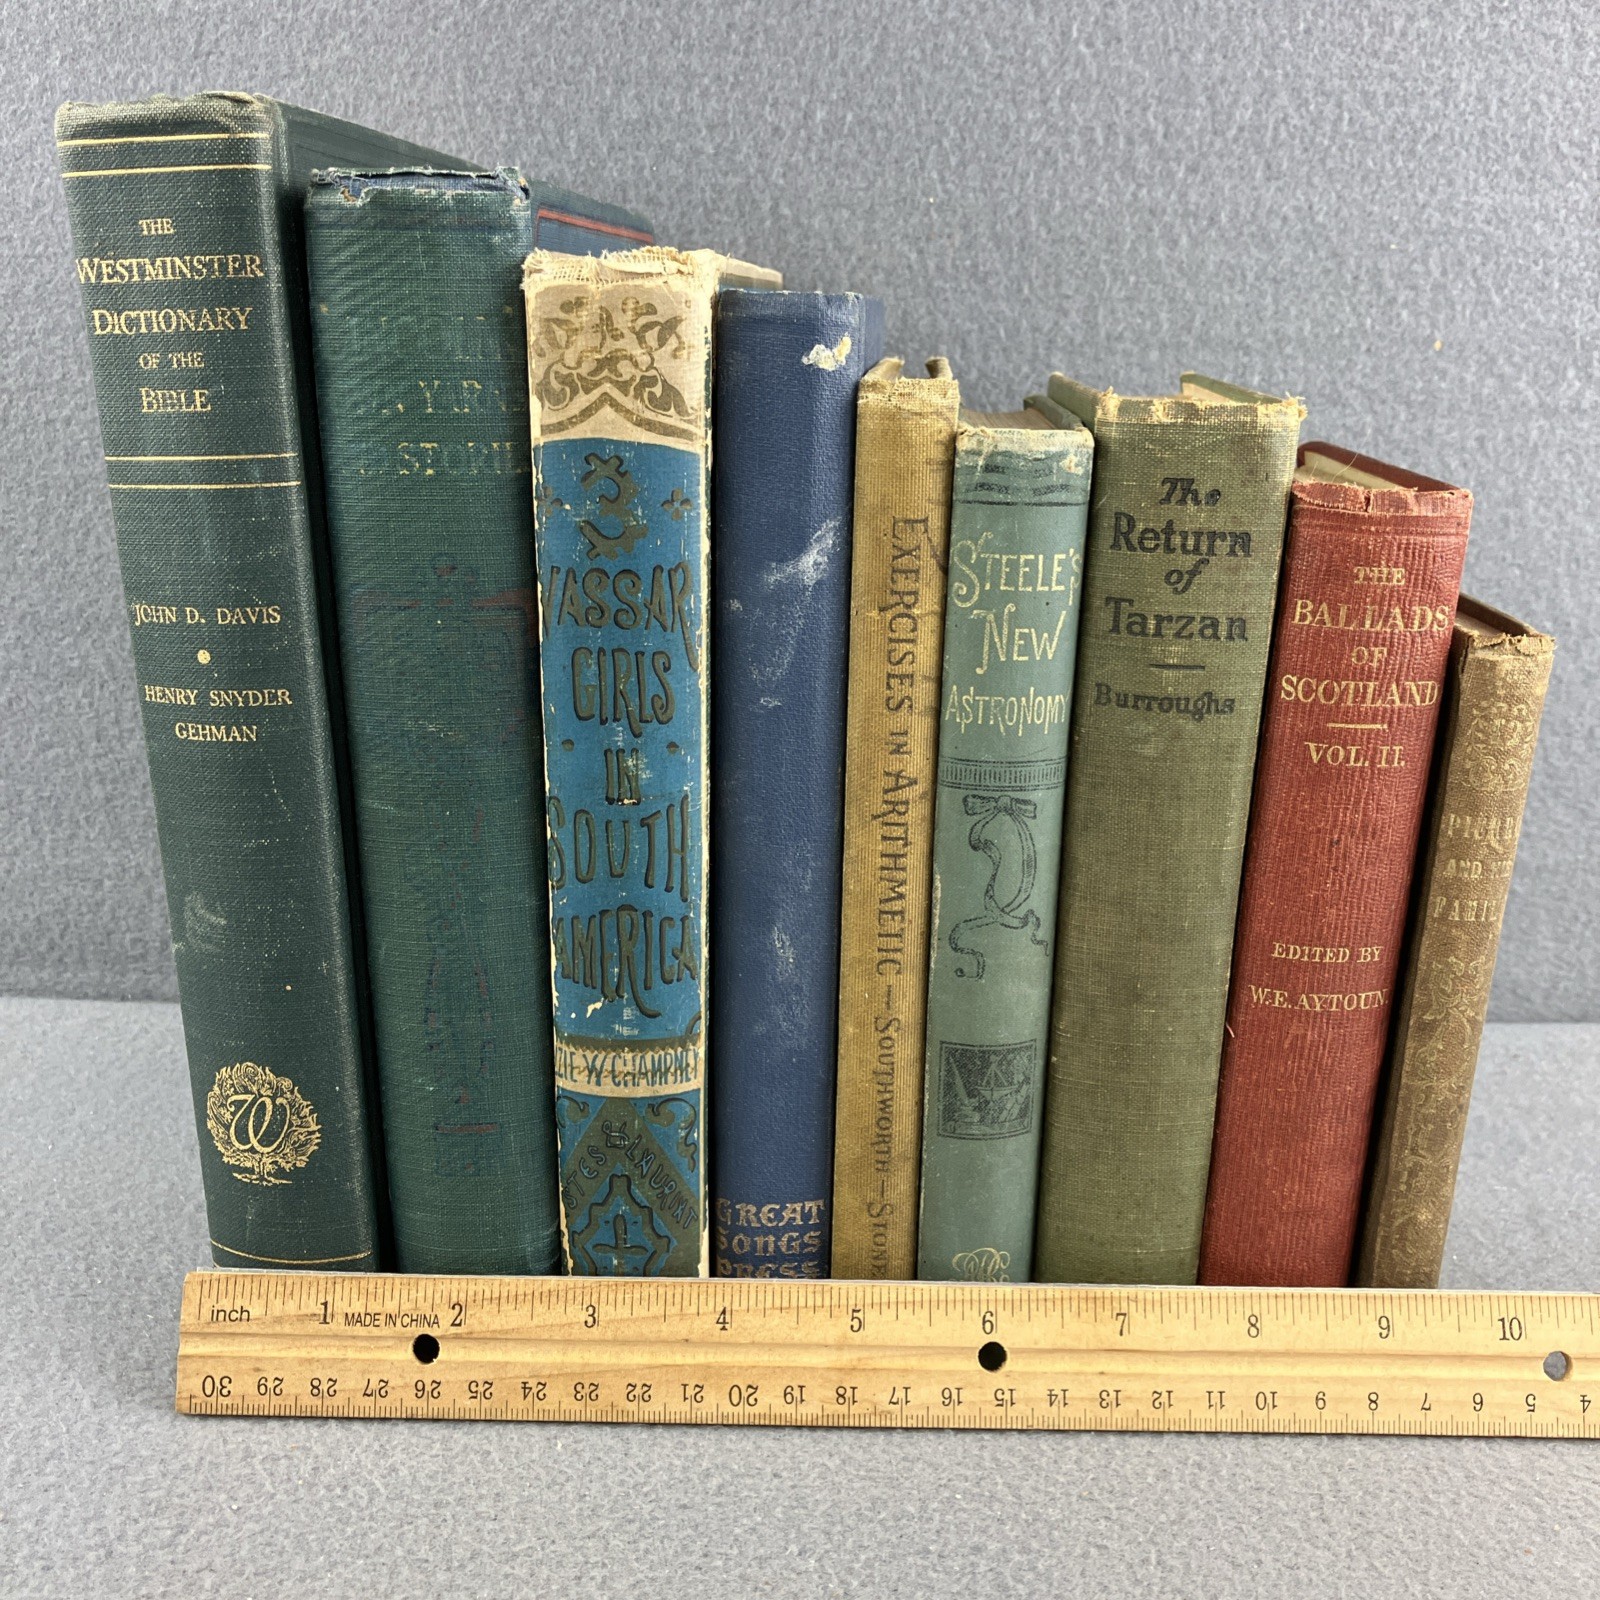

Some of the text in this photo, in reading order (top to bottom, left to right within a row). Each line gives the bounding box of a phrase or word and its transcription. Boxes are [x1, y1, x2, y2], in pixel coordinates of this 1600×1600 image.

[138, 218, 175, 235] THE
[75, 254, 265, 284] WESTMINSTER
[92, 307, 252, 335] DICTIONARY
[139, 352, 204, 369] OF THE
[140, 388, 212, 413] BIBLE
[1159, 477, 1221, 507] The
[1110, 512, 1251, 558] Return
[952, 531, 1083, 608] STEELE'S
[1164, 558, 1210, 595] of
[1353, 567, 1406, 586] THE
[134, 604, 281, 627] JOHN D. DAVIS
[879, 516, 929, 713] EXERCISES
[1105, 596, 1248, 642] Tarzan
[1292, 599, 1449, 632] BALLADS
[971, 603, 1066, 675] NEW
[1351, 646, 1388, 666] OF
[145, 685, 293, 707] HENRY SNYDER
[572, 646, 675, 738] GIRLS
[1095, 682, 1236, 722] Burroughs
[1281, 674, 1440, 706] SCOTLAND
[945, 685, 1071, 737] ASTRONOMY
[175, 722, 257, 742] GEHMAN
[885, 730, 912, 756] IN
[1304, 742, 1406, 767] VOL. II.
[604, 748, 641, 805] IN
[549, 795, 690, 903] SOUTH
[871, 769, 918, 976] ARITHMETIC
[555, 904, 697, 1018] AMERICA
[1271, 942, 1384, 963] EDITED BY
[716, 1198, 825, 1227] GREAT
[716, 1226, 821, 1256] SONGS
[211, 1305, 251, 1322] inch
[319, 1301, 1522, 1341] 1 2 3 4 5 6 7 8 9 10
[344, 1312, 440, 1329] MADE IN CHINA
[202, 1375, 1591, 1414] 4 5 6 7 8 9 10 11 12 13 14 15 16 17 18 19 20 21 22 23 24 25 26 27 28 29 30
